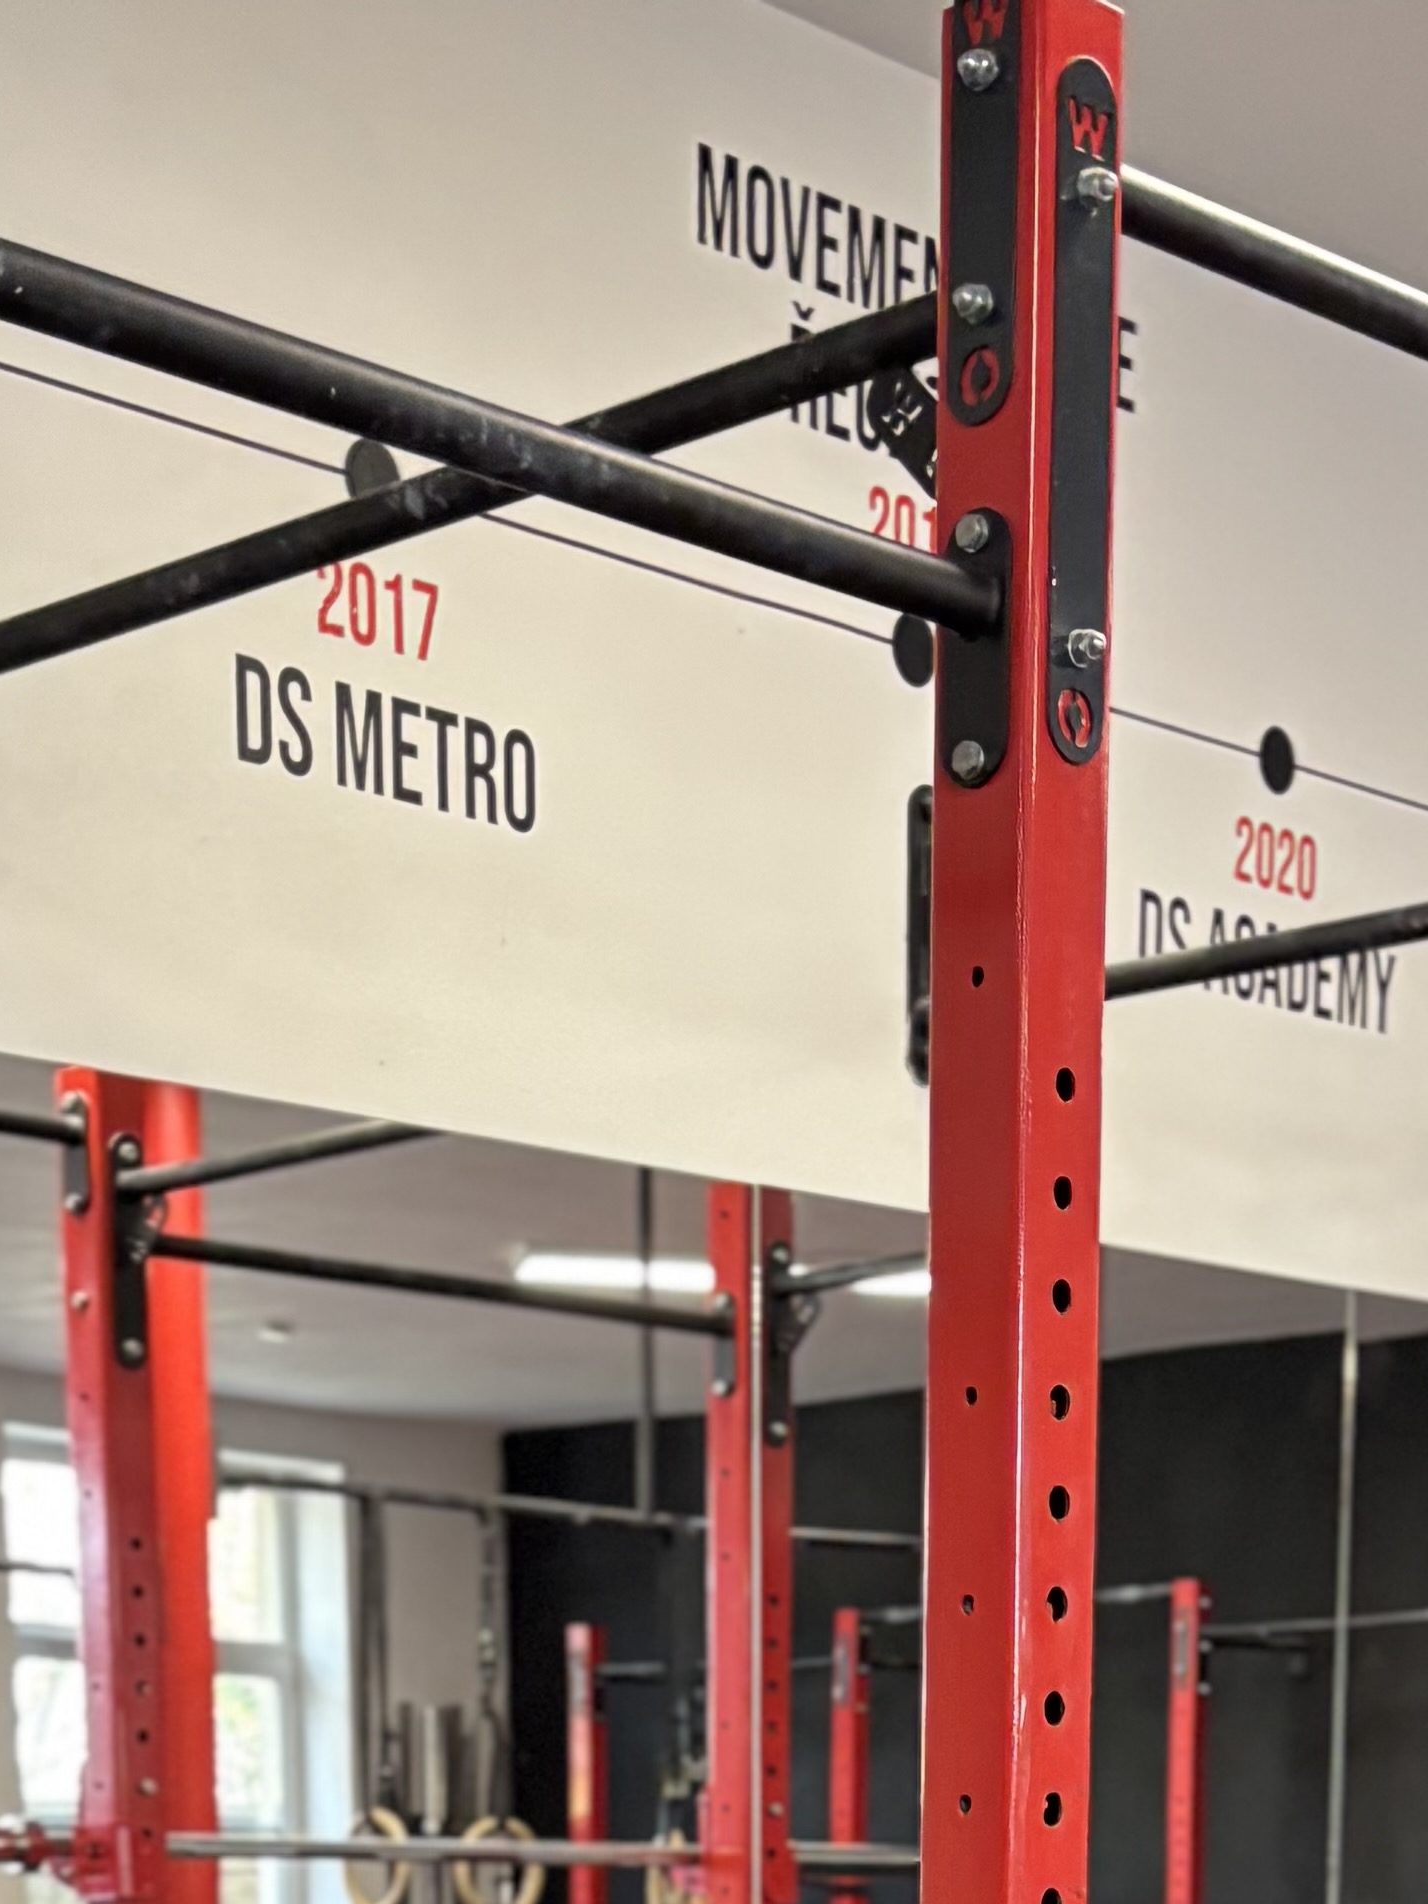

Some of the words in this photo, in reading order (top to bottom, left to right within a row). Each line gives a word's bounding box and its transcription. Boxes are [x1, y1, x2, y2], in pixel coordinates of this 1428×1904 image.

[316, 560, 440, 661] 2017
[235, 653, 313, 778] DS
[334, 681, 537, 833] METRO
[1234, 816, 1318, 901] 2020
